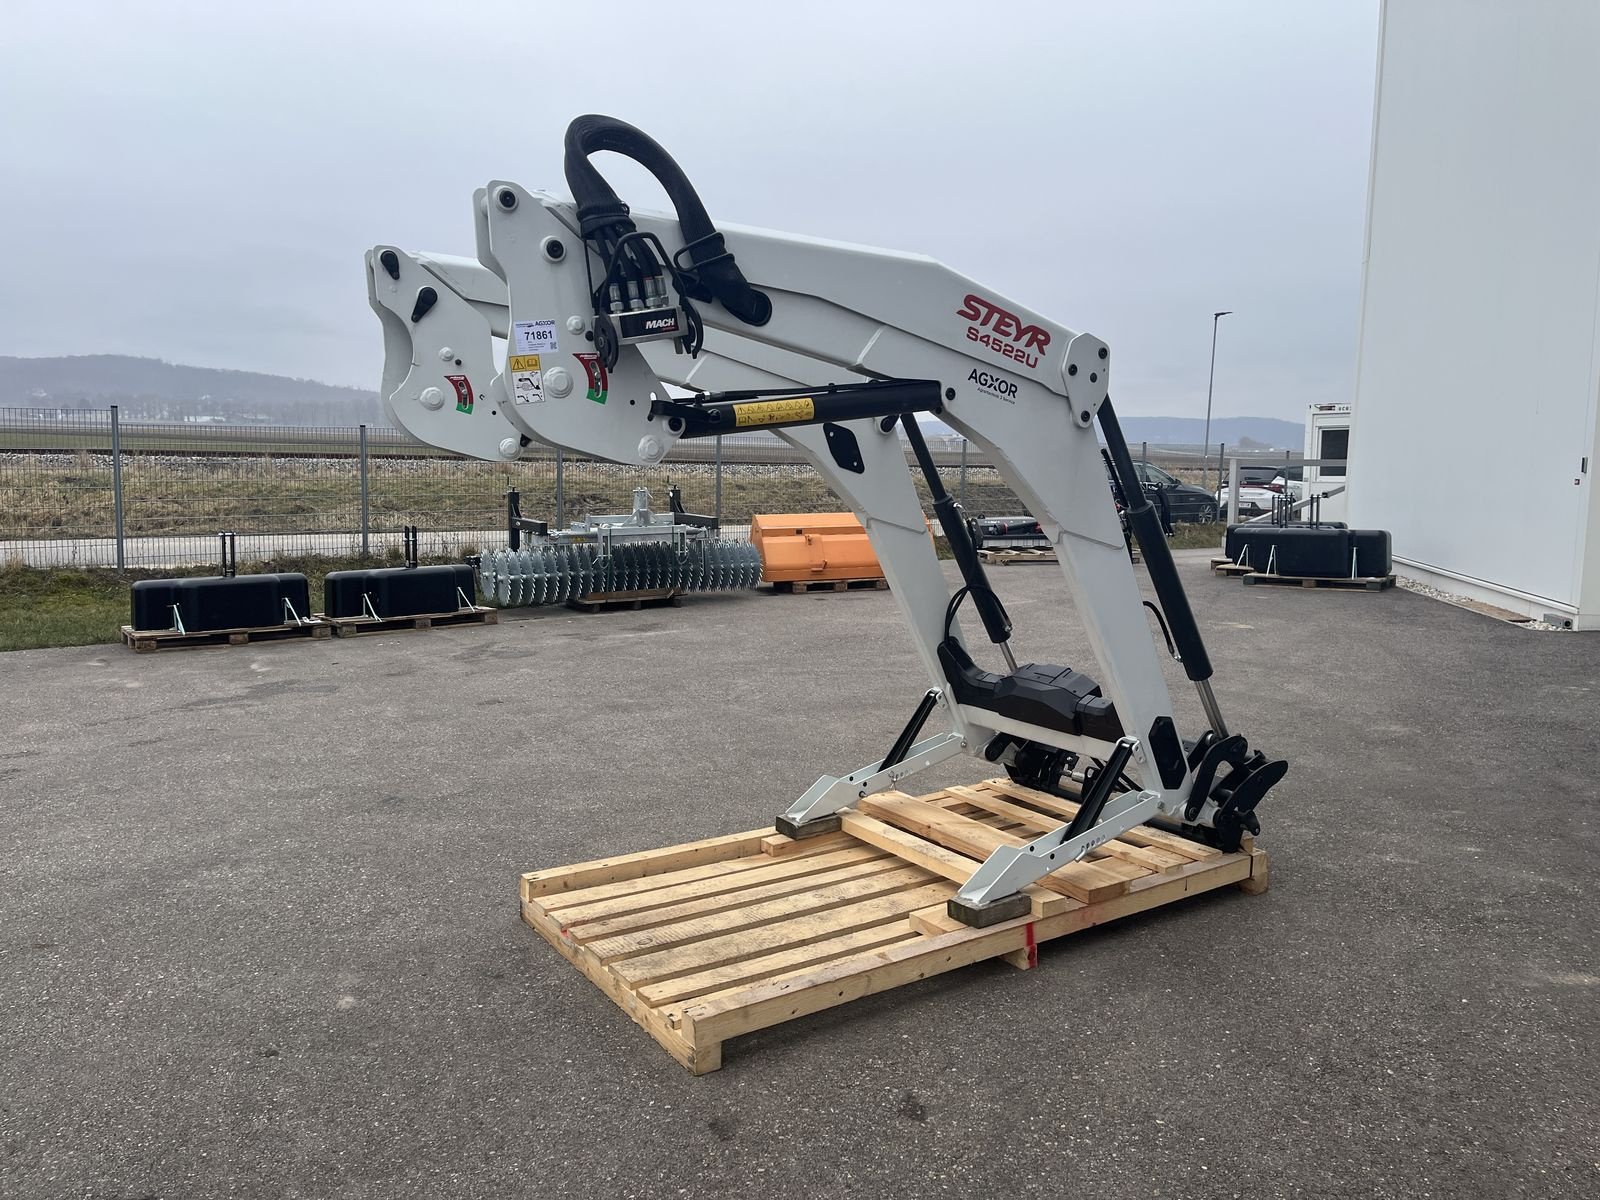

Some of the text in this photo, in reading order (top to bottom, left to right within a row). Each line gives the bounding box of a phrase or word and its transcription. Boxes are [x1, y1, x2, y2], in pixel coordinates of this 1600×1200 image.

[524, 330, 553, 341] 71861
[645, 318, 675, 330] MACH
[956, 294, 1051, 356] STEYR
[966, 326, 1038, 369] S4522U
[967, 368, 1018, 399] AGXOR
